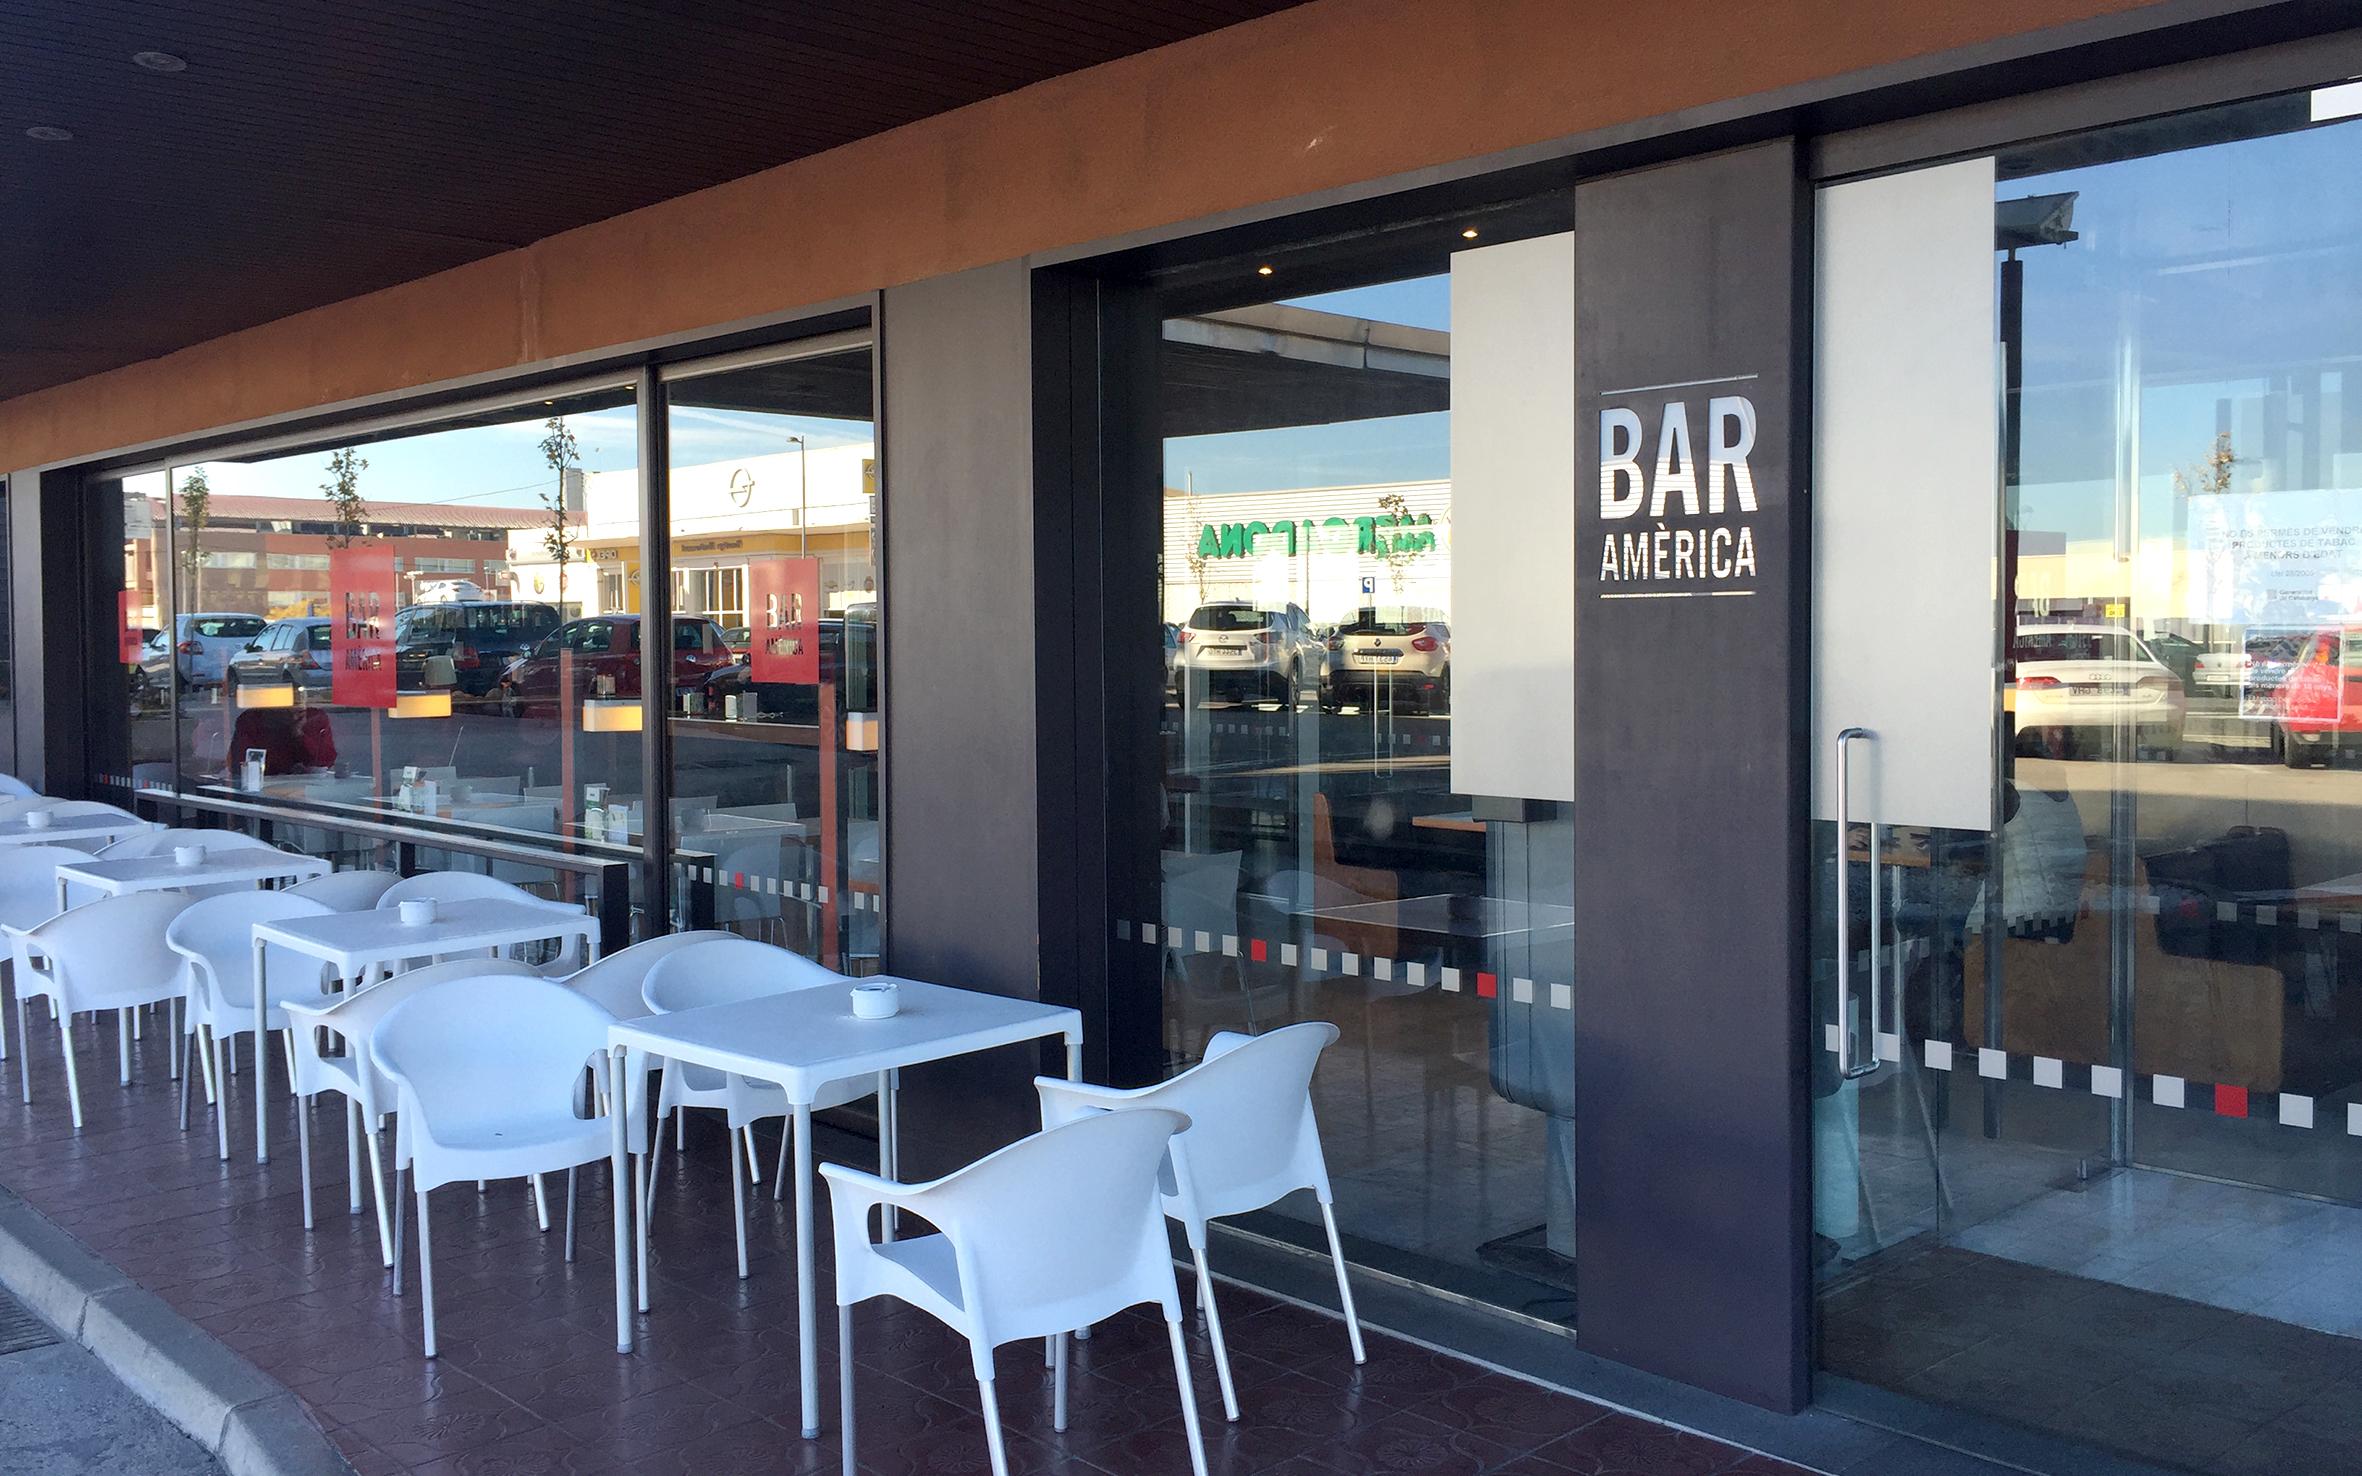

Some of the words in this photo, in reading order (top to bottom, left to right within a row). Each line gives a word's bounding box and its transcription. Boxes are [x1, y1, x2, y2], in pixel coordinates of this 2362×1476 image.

[1600, 396, 1758, 520] BAR
[2300, 539, 2315, 547] DE
[2318, 538, 2356, 547] TABAC
[2304, 527, 2319, 536] DE
[1599, 522, 1757, 581] AMÈRICA
